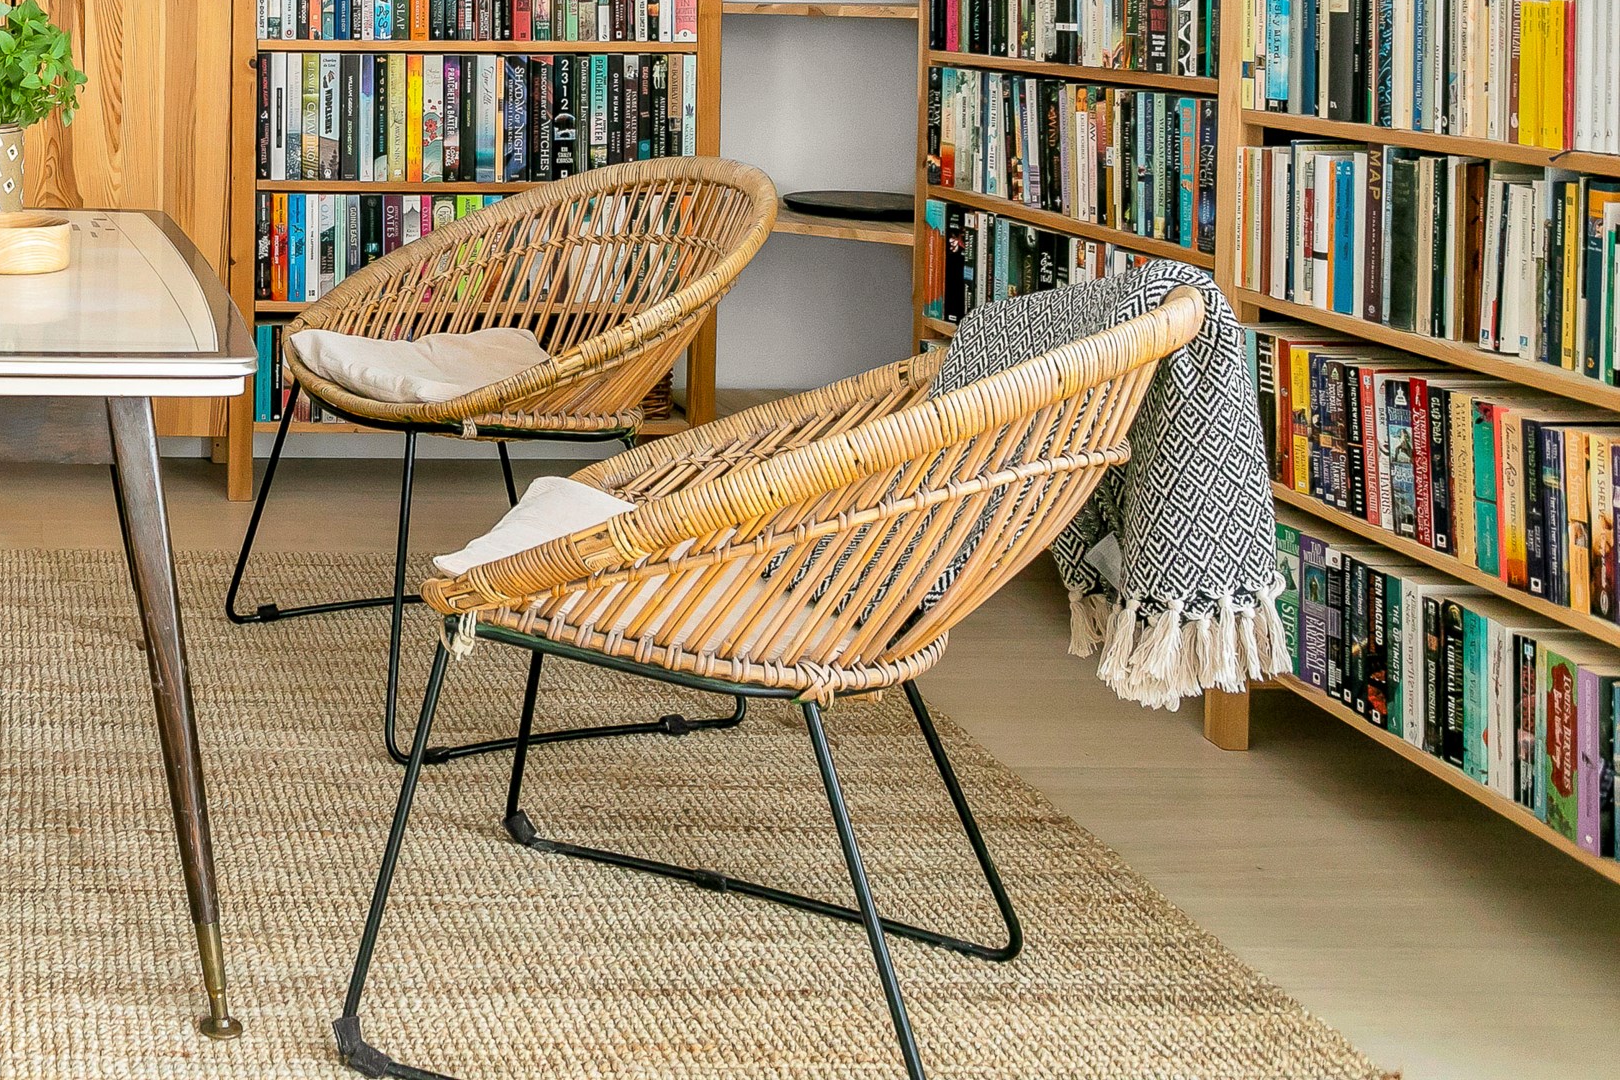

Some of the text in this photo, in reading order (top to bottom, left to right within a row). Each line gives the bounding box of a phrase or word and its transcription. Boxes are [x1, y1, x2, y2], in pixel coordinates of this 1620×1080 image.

[397, 3, 406, 30] SLAP
[1274, 5, 1282, 26] Sky
[595, 58, 603, 141] PRATCHETT BAXTER
[514, 126, 524, 163] NIGHT
[1370, 150, 1381, 200] MAP
[387, 206, 395, 237] OATES
[1260, 350, 1274, 392] Hill
[1351, 387, 1359, 441] NEVERWHERE
[1597, 442, 1606, 520] ANITA SHREVE
[1428, 660, 1437, 723] JOHN GRISHAM
